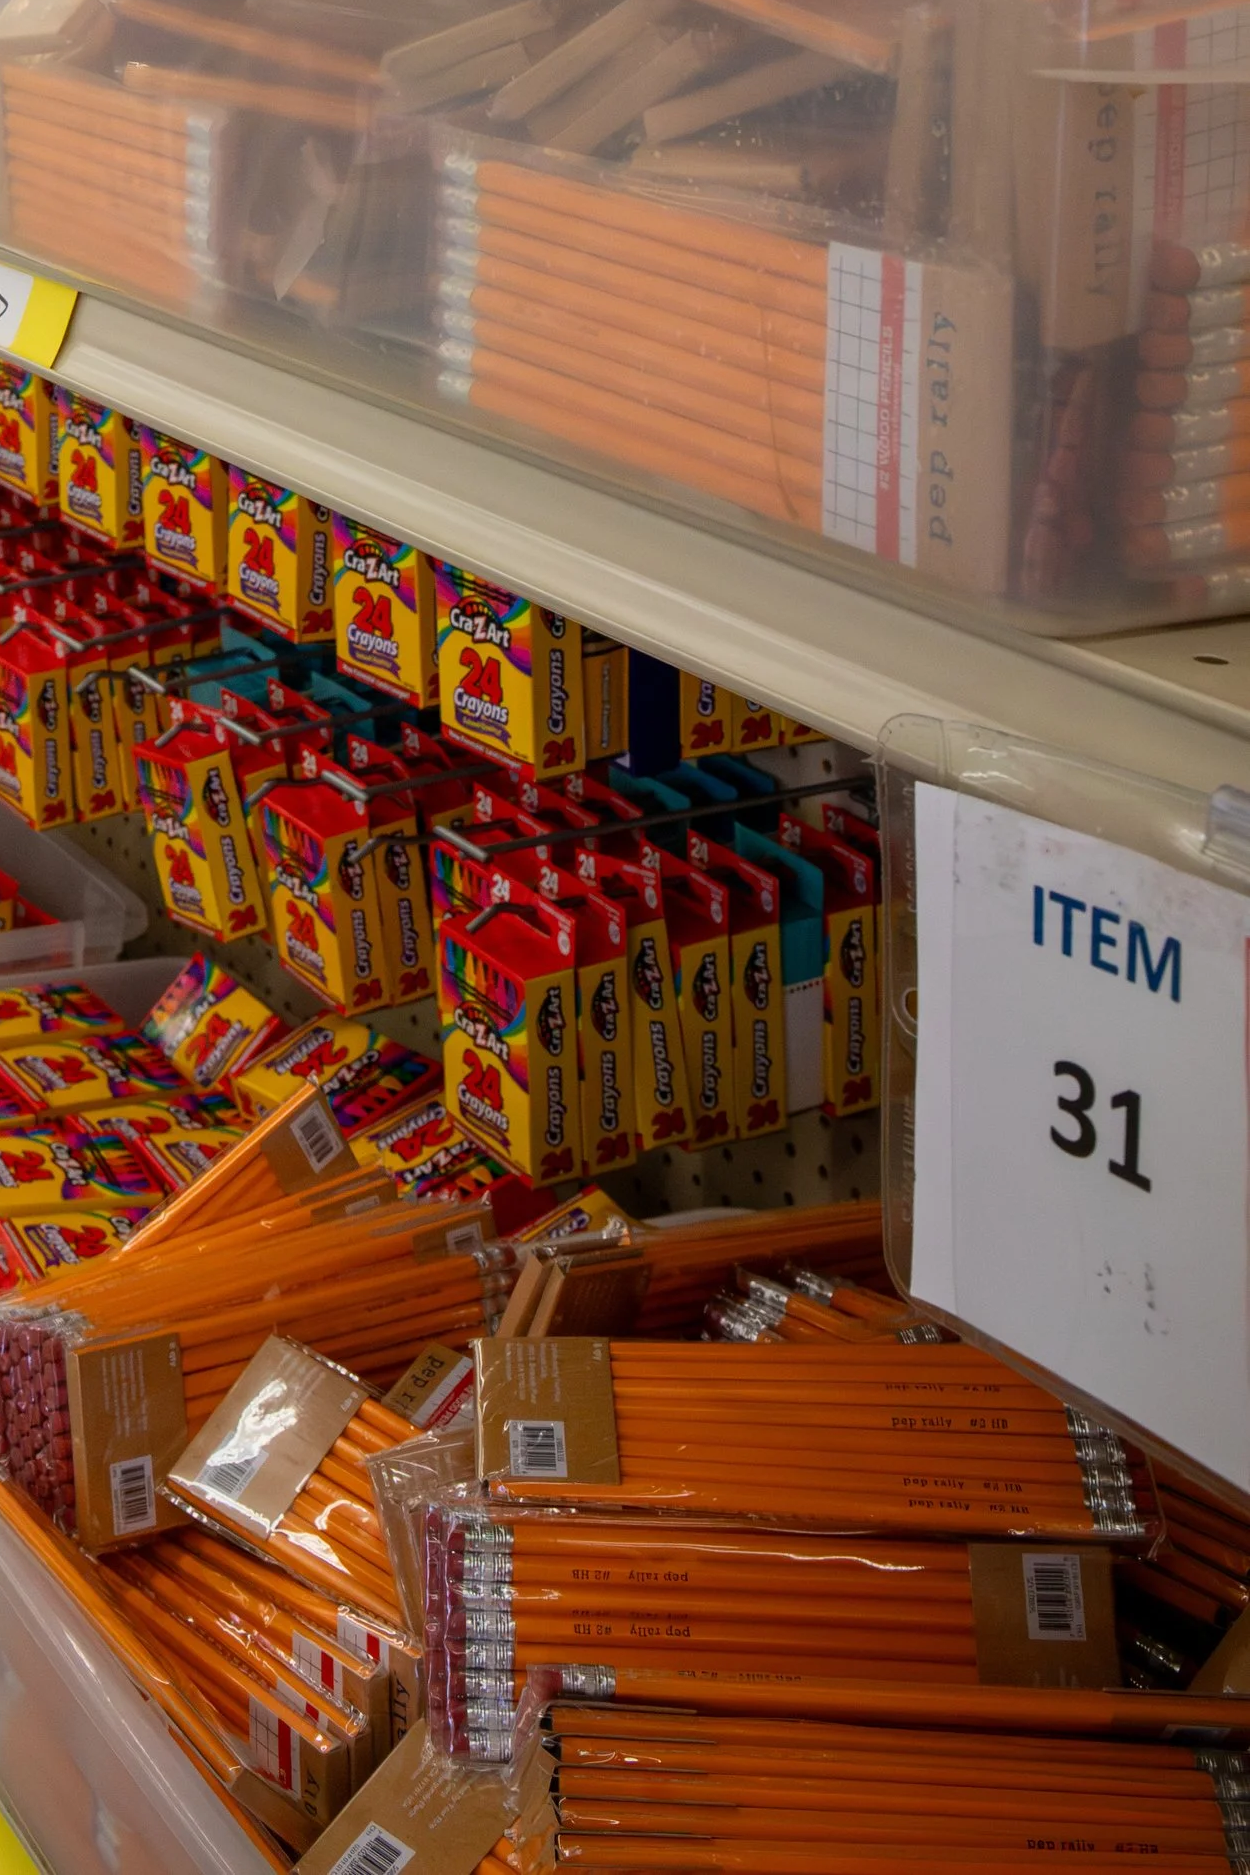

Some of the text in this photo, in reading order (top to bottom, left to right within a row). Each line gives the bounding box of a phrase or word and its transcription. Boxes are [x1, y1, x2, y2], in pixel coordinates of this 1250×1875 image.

[880, 325, 894, 404] PENCILS
[879, 407, 892, 466] WOOD
[926, 311, 957, 547] pep rally
[71, 448, 98, 494] 24
[128, 448, 142, 516] Crayons
[155, 523, 197, 551] Crayons
[157, 488, 192, 535] 24
[243, 527, 275, 576] 24
[309, 530, 326, 606] Crayons
[238, 563, 280, 597] Crayons
[352, 586, 393, 640] 24
[346, 623, 400, 658] Crayons
[459, 646, 503, 706] 24
[549, 648, 568, 735] Crayons
[453, 687, 509, 725] Crayons
[543, 737, 576, 769] 24
[476, 790, 493, 817] 24
[220, 835, 245, 905] Crayons
[578, 853, 596, 880] 24
[689, 838, 710, 864] 24
[491, 872, 511, 904] 24
[539, 865, 559, 896] 24
[285, 900, 320, 952] 24
[352, 909, 373, 977] Crayons
[398, 898, 419, 967] Crayons
[1032, 885, 1183, 1004] ITEM
[752, 1019, 772, 1098] Crayons
[847, 996, 866, 1075] Crayons
[462, 1049, 504, 1111] 24
[649, 1021, 674, 1106] Crayons
[700, 1031, 721, 1109] Crayons
[457, 1082, 509, 1133] Crayons
[546, 1066, 567, 1146] Crayons
[601, 1050, 621, 1132] Crayons
[376, 1106, 447, 1151] Crayons
[1050, 1060, 1153, 1194] 31
[413, 1355, 445, 1389] pep
[891, 1417, 917, 1429] pep
[921, 1416, 953, 1427] rally
[628, 1570, 658, 1582] rally
[663, 1572, 689, 1582] pep
[630, 1623, 661, 1637] rally
[665, 1625, 691, 1638] pep
